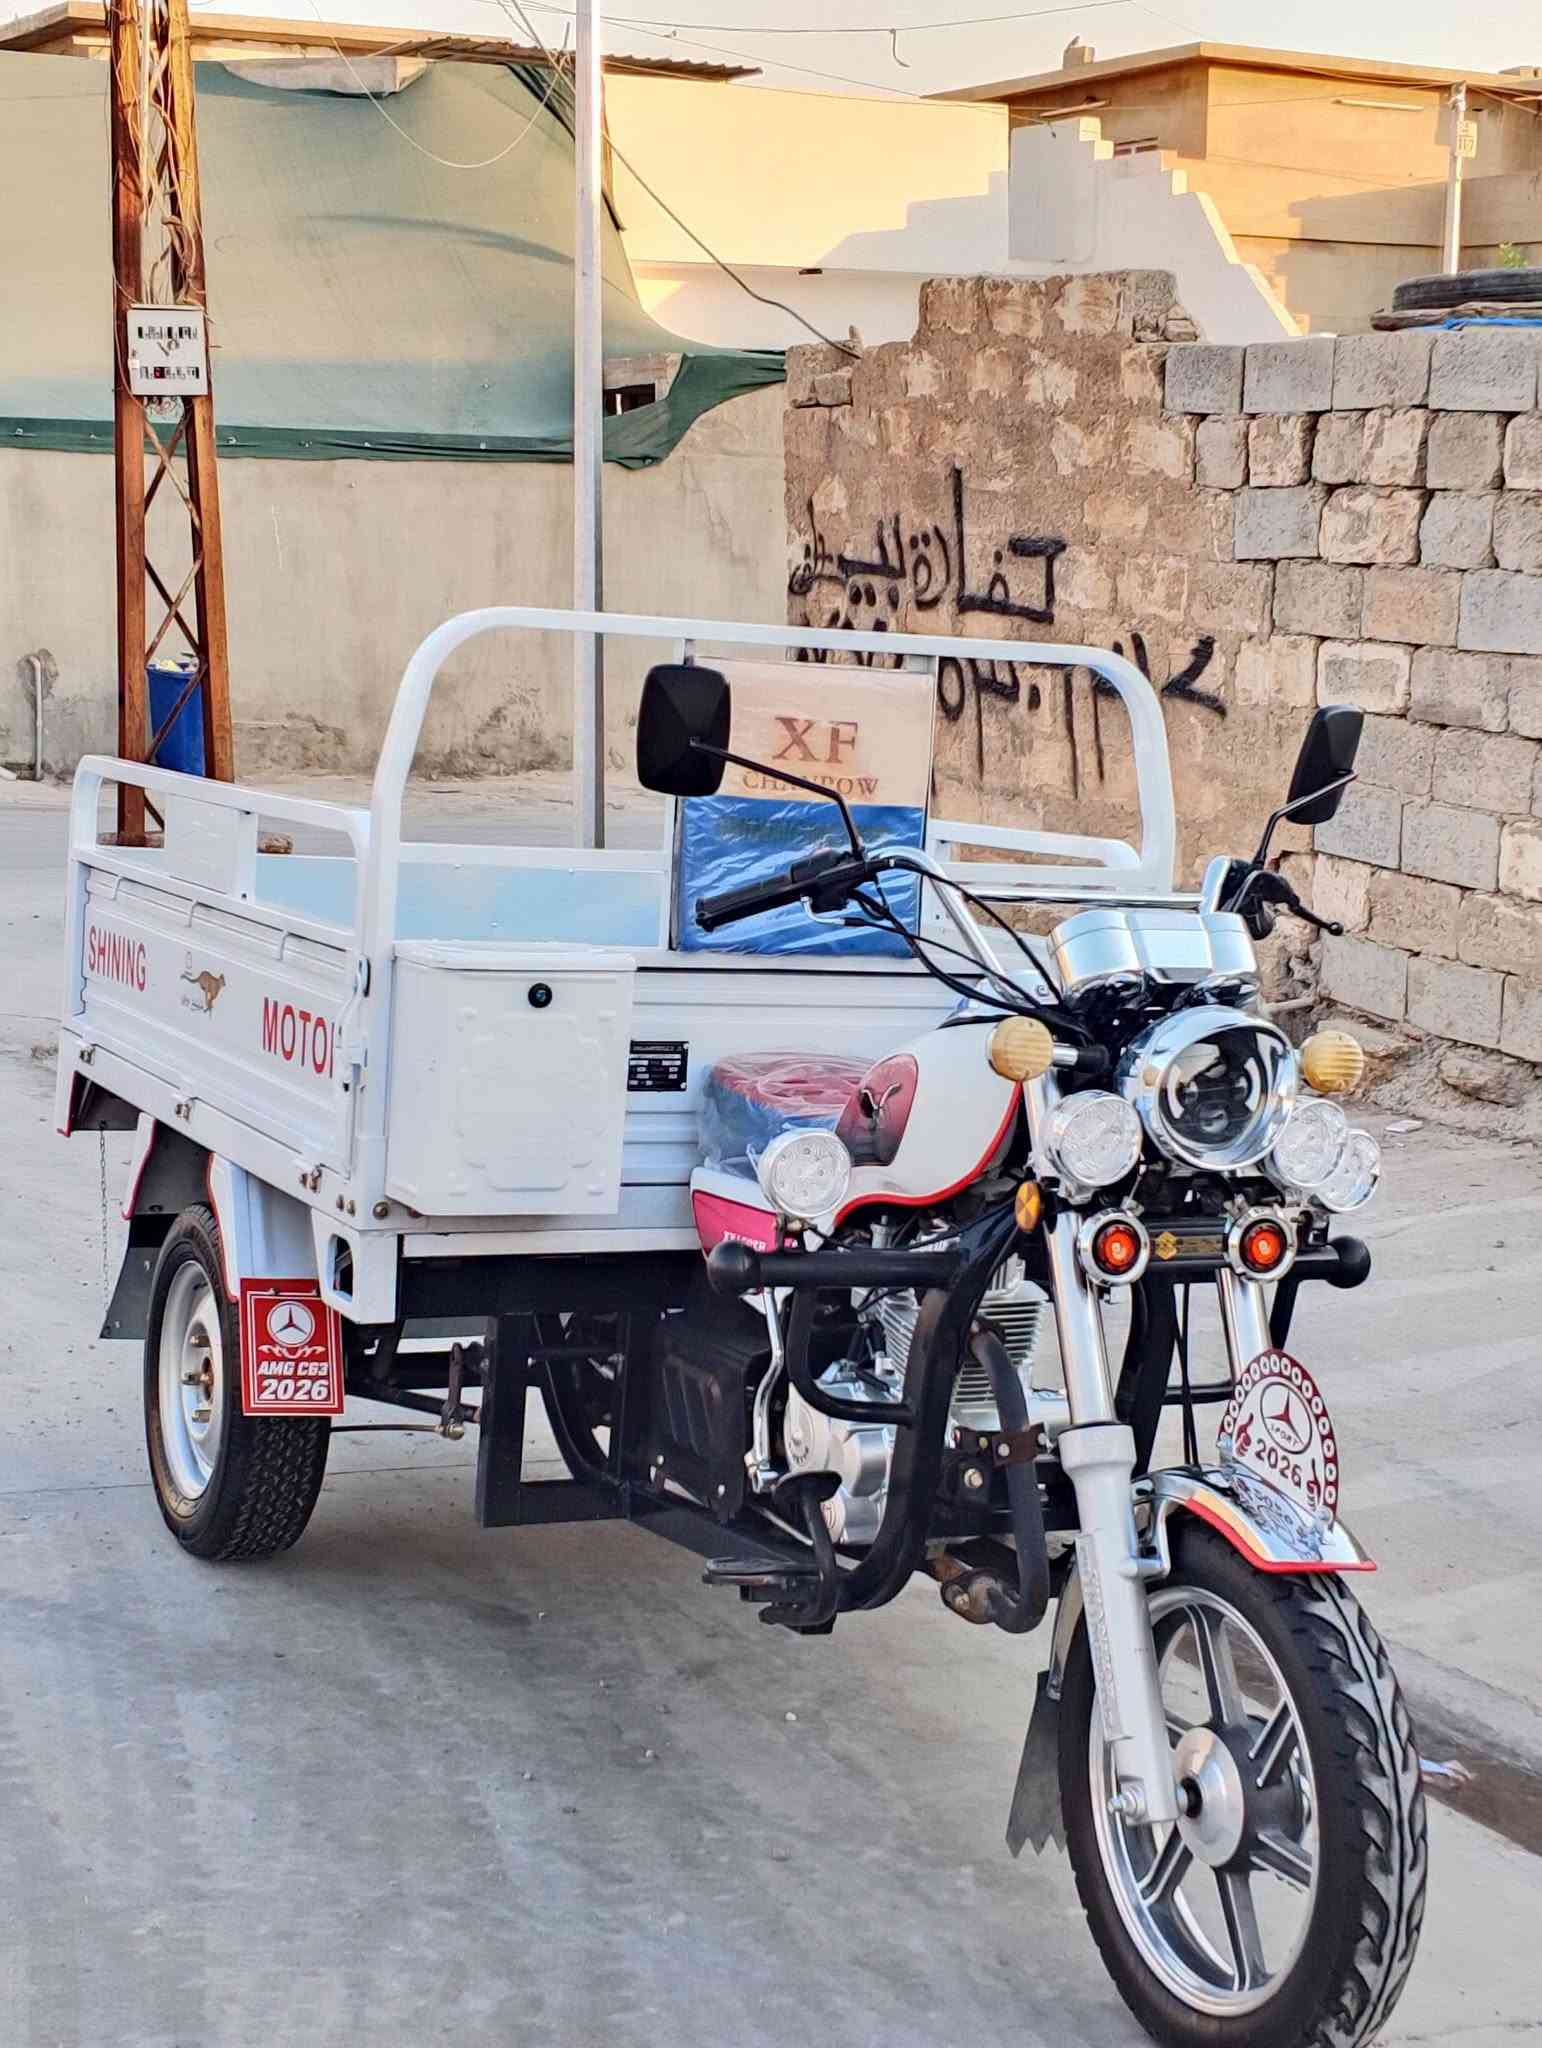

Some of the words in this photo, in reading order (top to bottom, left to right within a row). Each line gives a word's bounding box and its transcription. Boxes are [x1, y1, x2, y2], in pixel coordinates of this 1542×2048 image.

[772, 716, 858, 764] XF
[88, 925, 147, 992] SHINING
[262, 997, 336, 1079] MOTO
[258, 1361, 296, 1376] AMG
[259, 1379, 329, 1401] 2026
[1255, 1439, 1302, 1488] 2026
